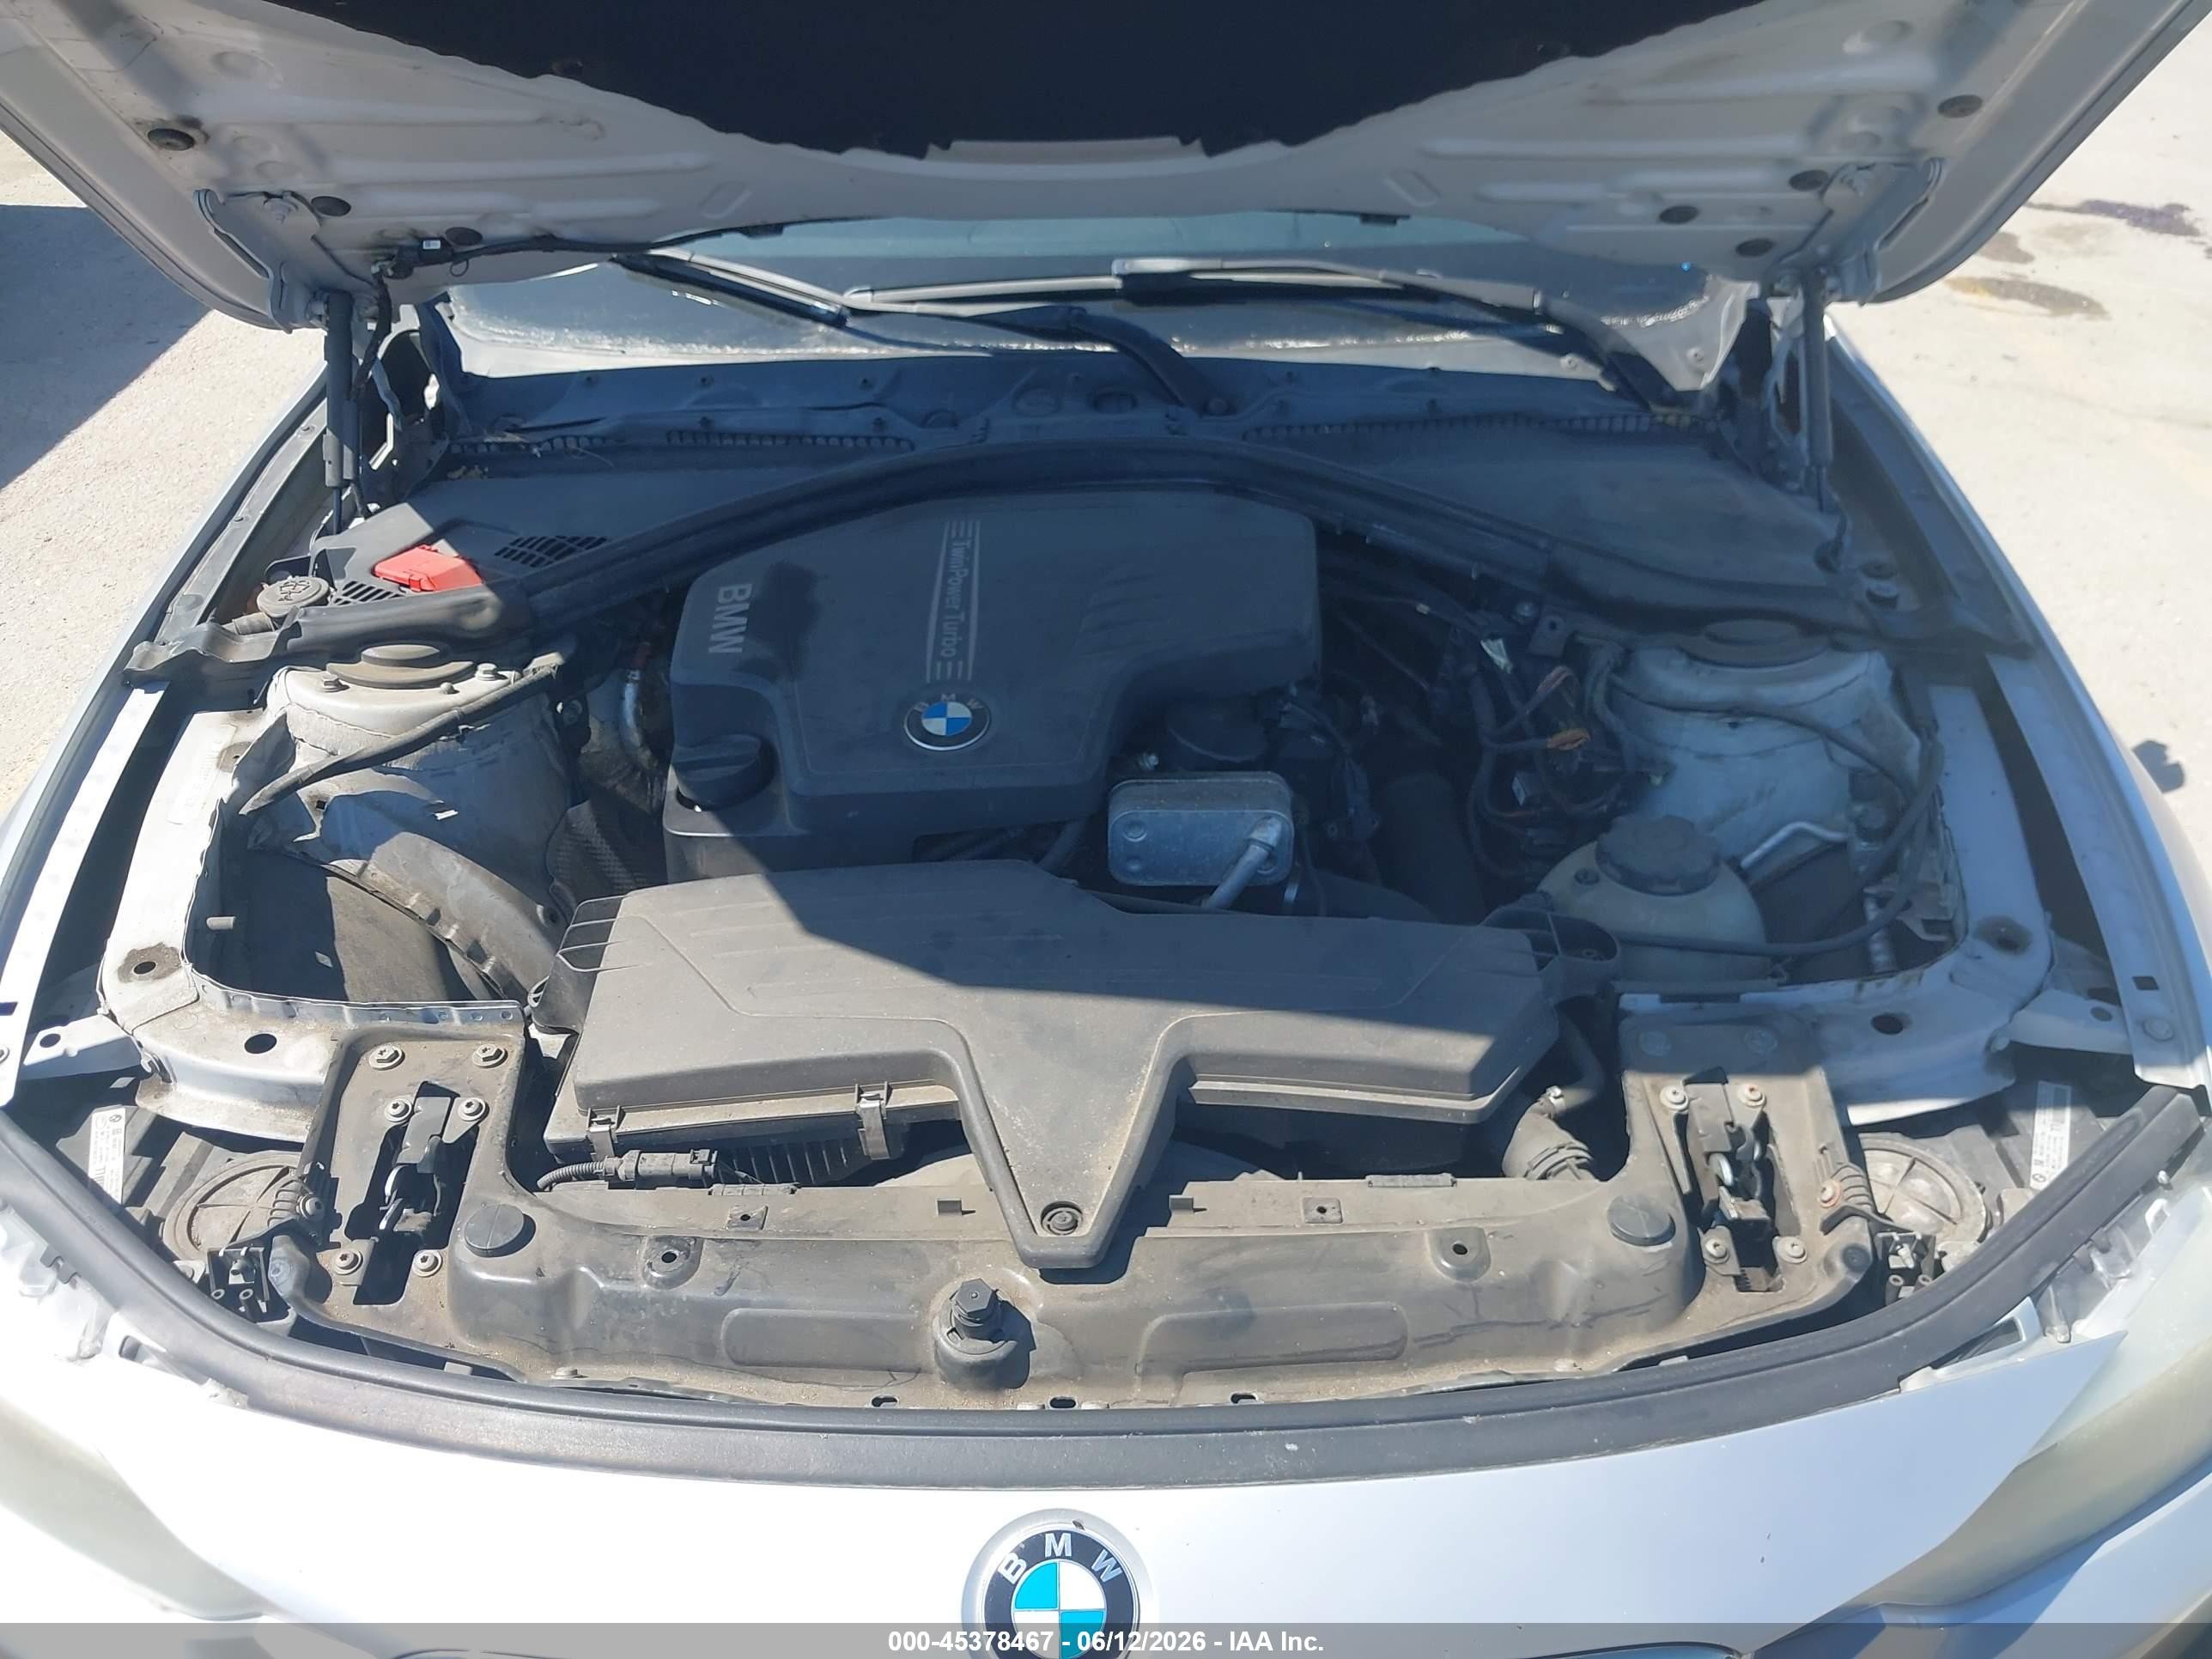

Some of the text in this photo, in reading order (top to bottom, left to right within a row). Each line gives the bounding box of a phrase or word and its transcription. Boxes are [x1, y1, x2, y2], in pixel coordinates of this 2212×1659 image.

[708, 583, 752, 653] BMW
[940, 538, 971, 658] TwinPower Turbo
[913, 693, 985, 713] BMW
[998, 1533, 1123, 1585] BMW
